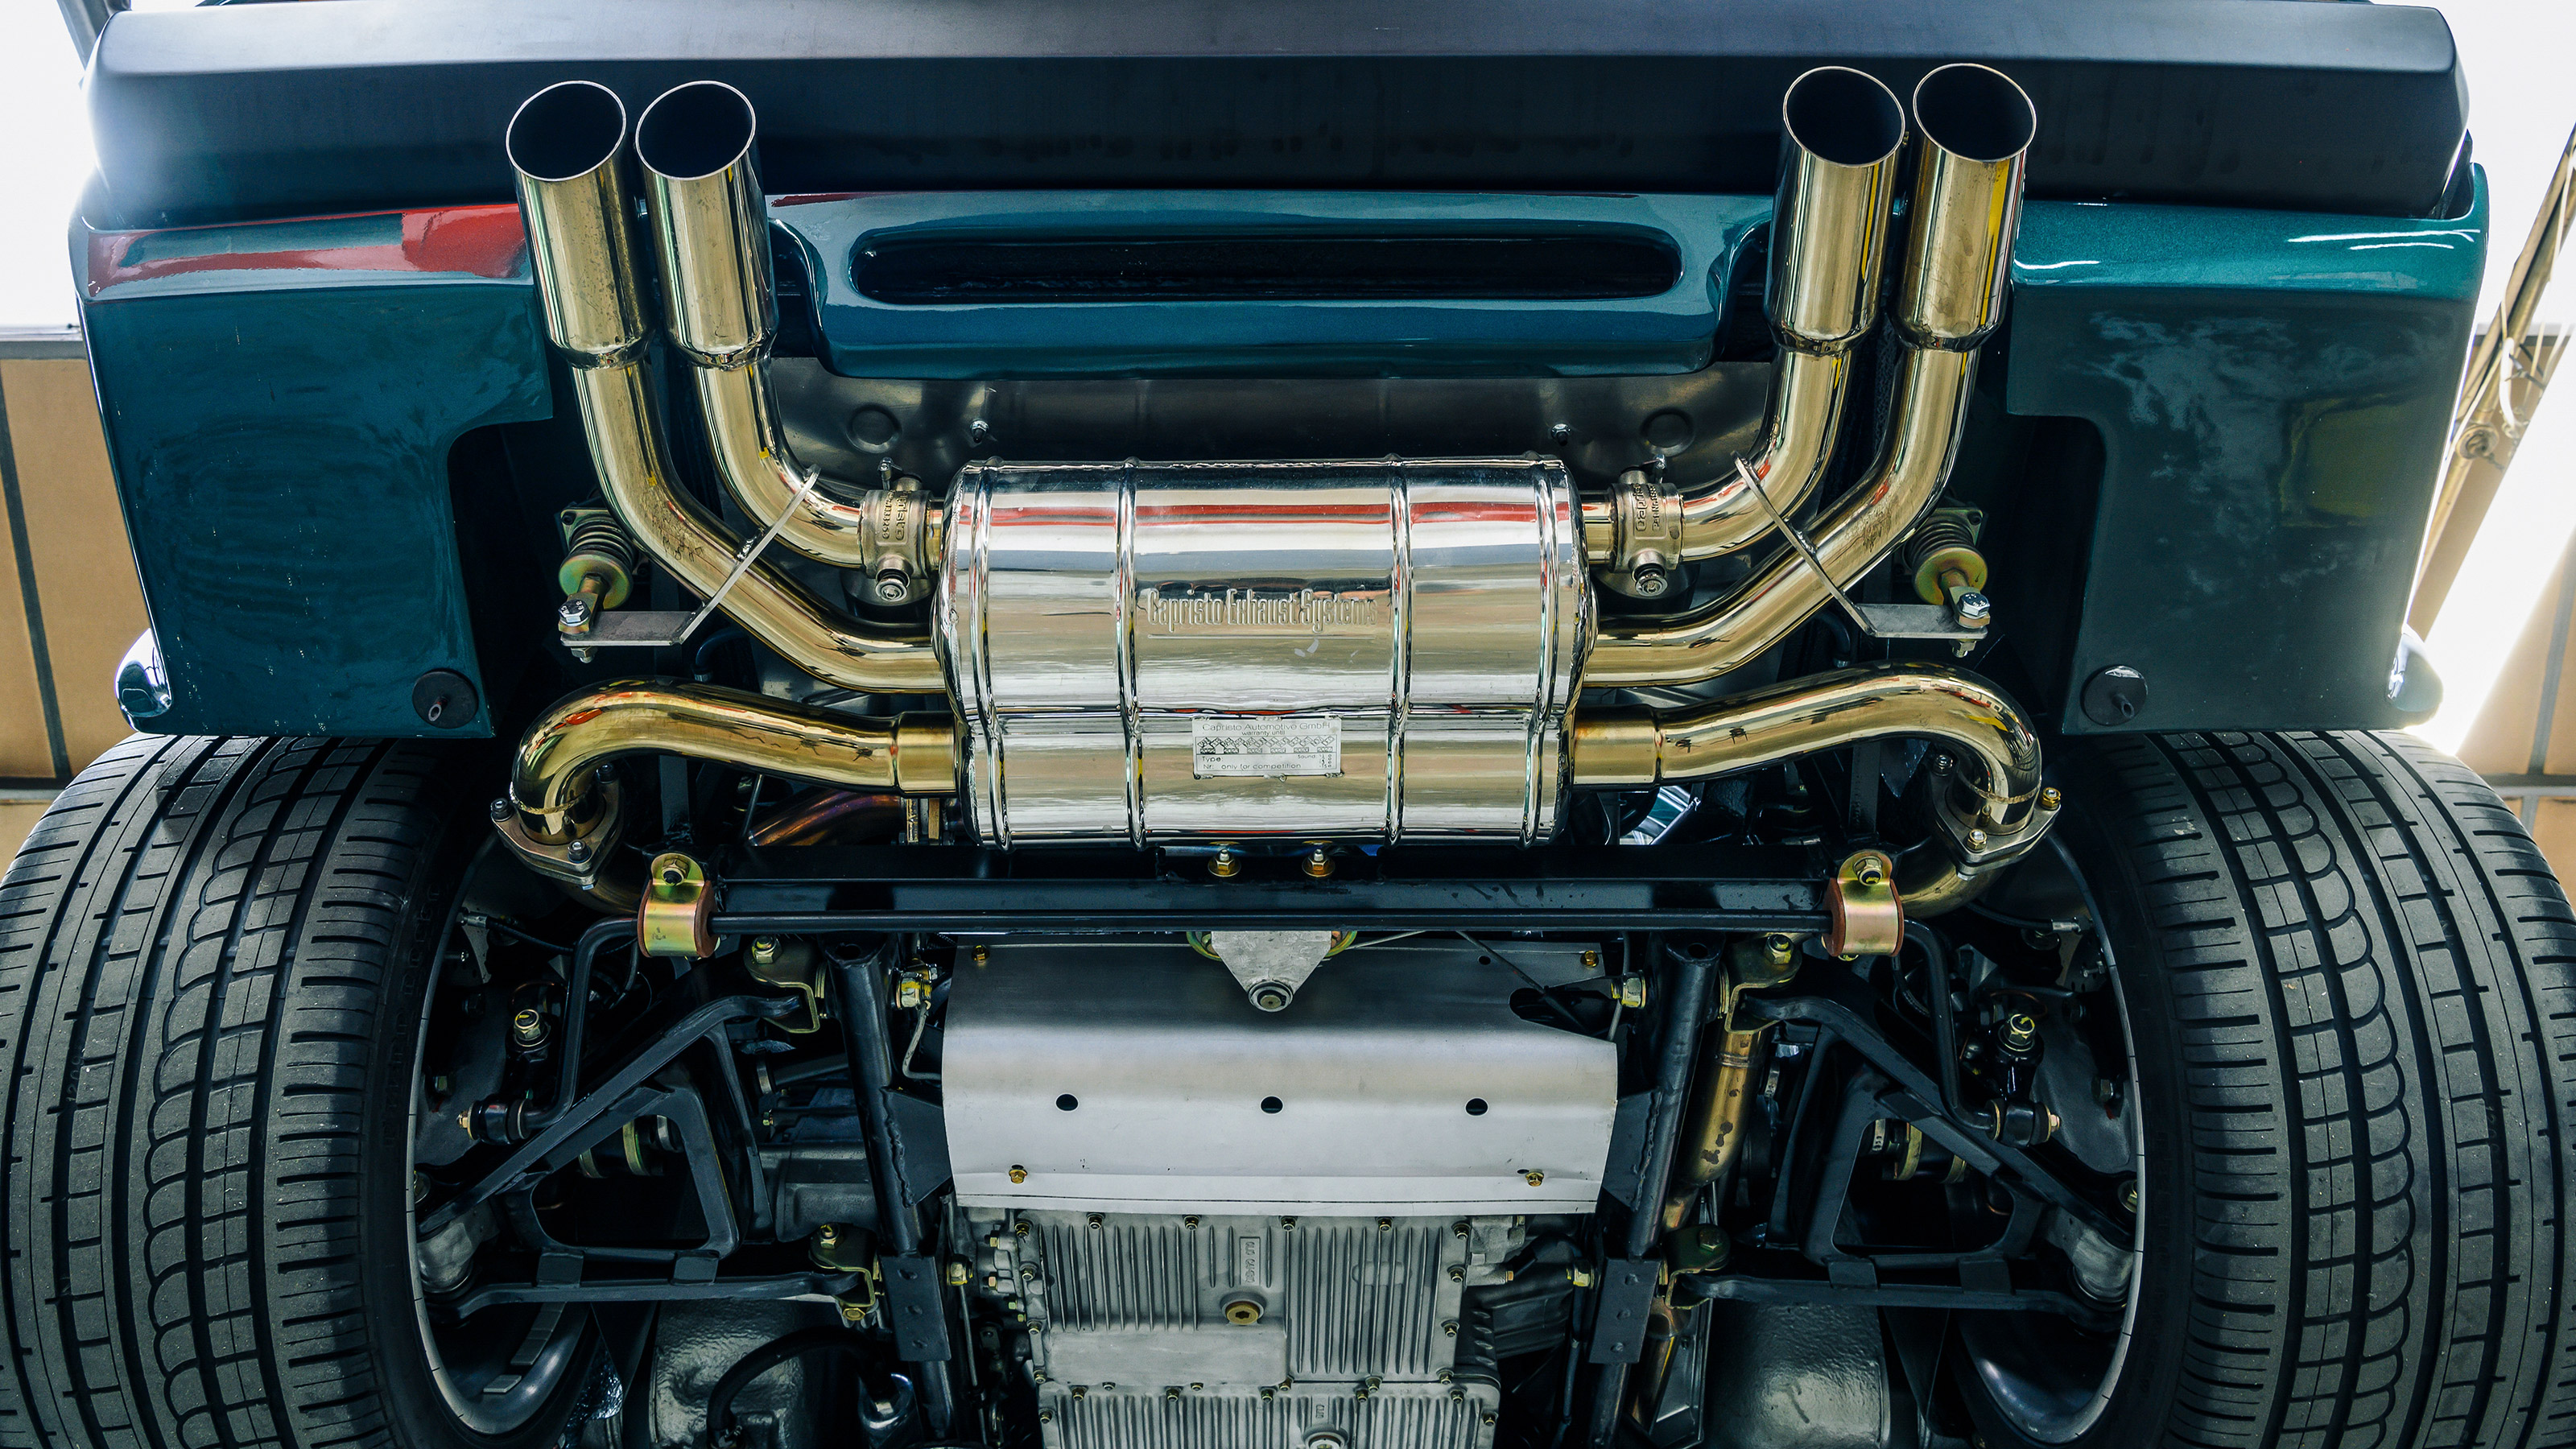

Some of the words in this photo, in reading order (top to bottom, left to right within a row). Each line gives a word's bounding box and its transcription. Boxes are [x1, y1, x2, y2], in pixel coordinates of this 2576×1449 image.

[1148, 588, 1223, 633] Capristo
[1228, 588, 1297, 625] Exhaust
[1301, 588, 1377, 633] Systems
[1203, 724, 1242, 732] Capristo
